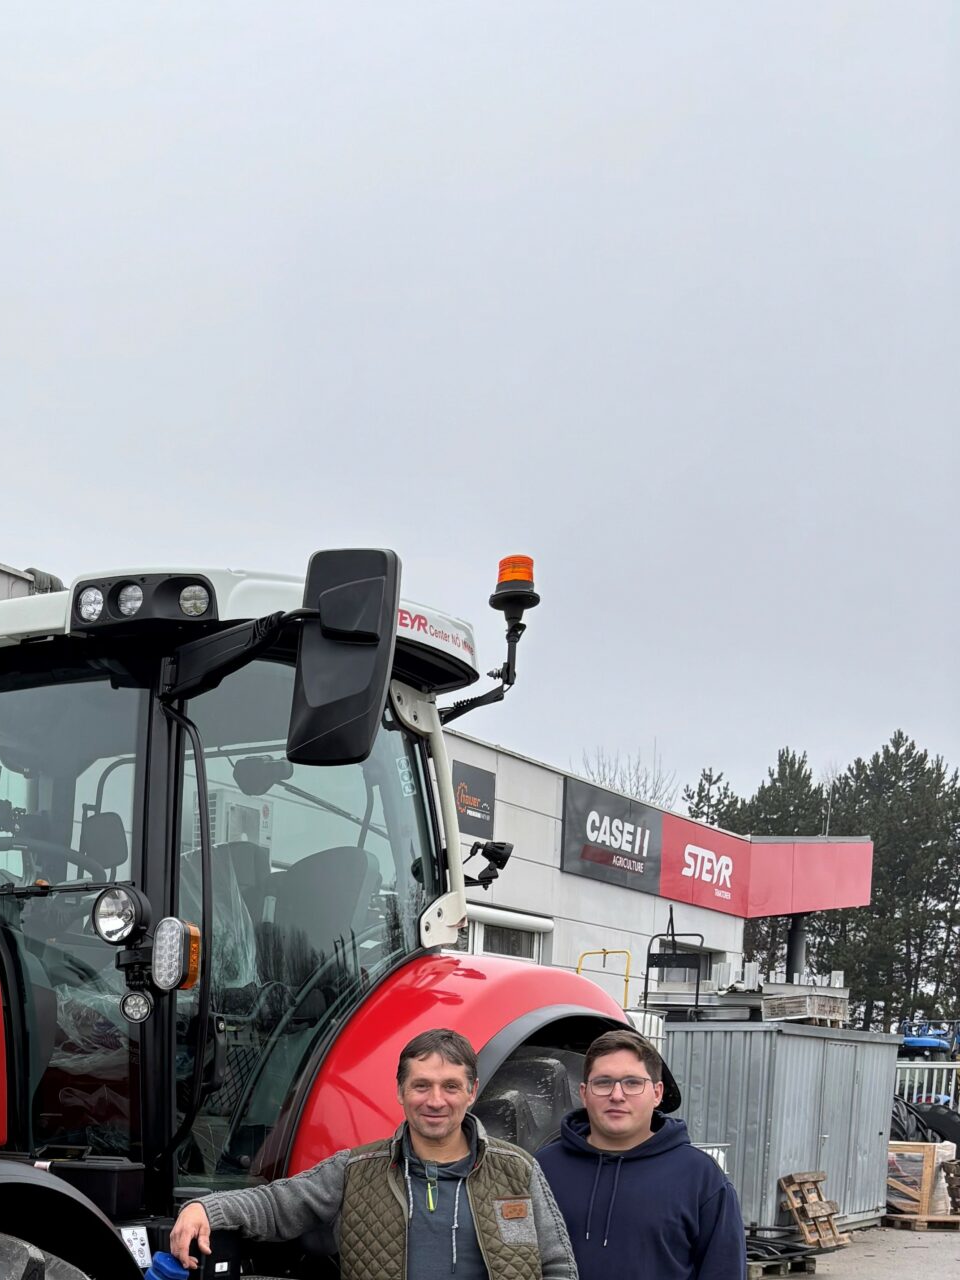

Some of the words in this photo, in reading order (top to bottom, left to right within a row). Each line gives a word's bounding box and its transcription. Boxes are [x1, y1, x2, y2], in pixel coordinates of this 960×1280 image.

[397, 608, 428, 634] EYR
[612, 855, 644, 873] AGRICULTURE
[681, 843, 733, 888] STEYR
